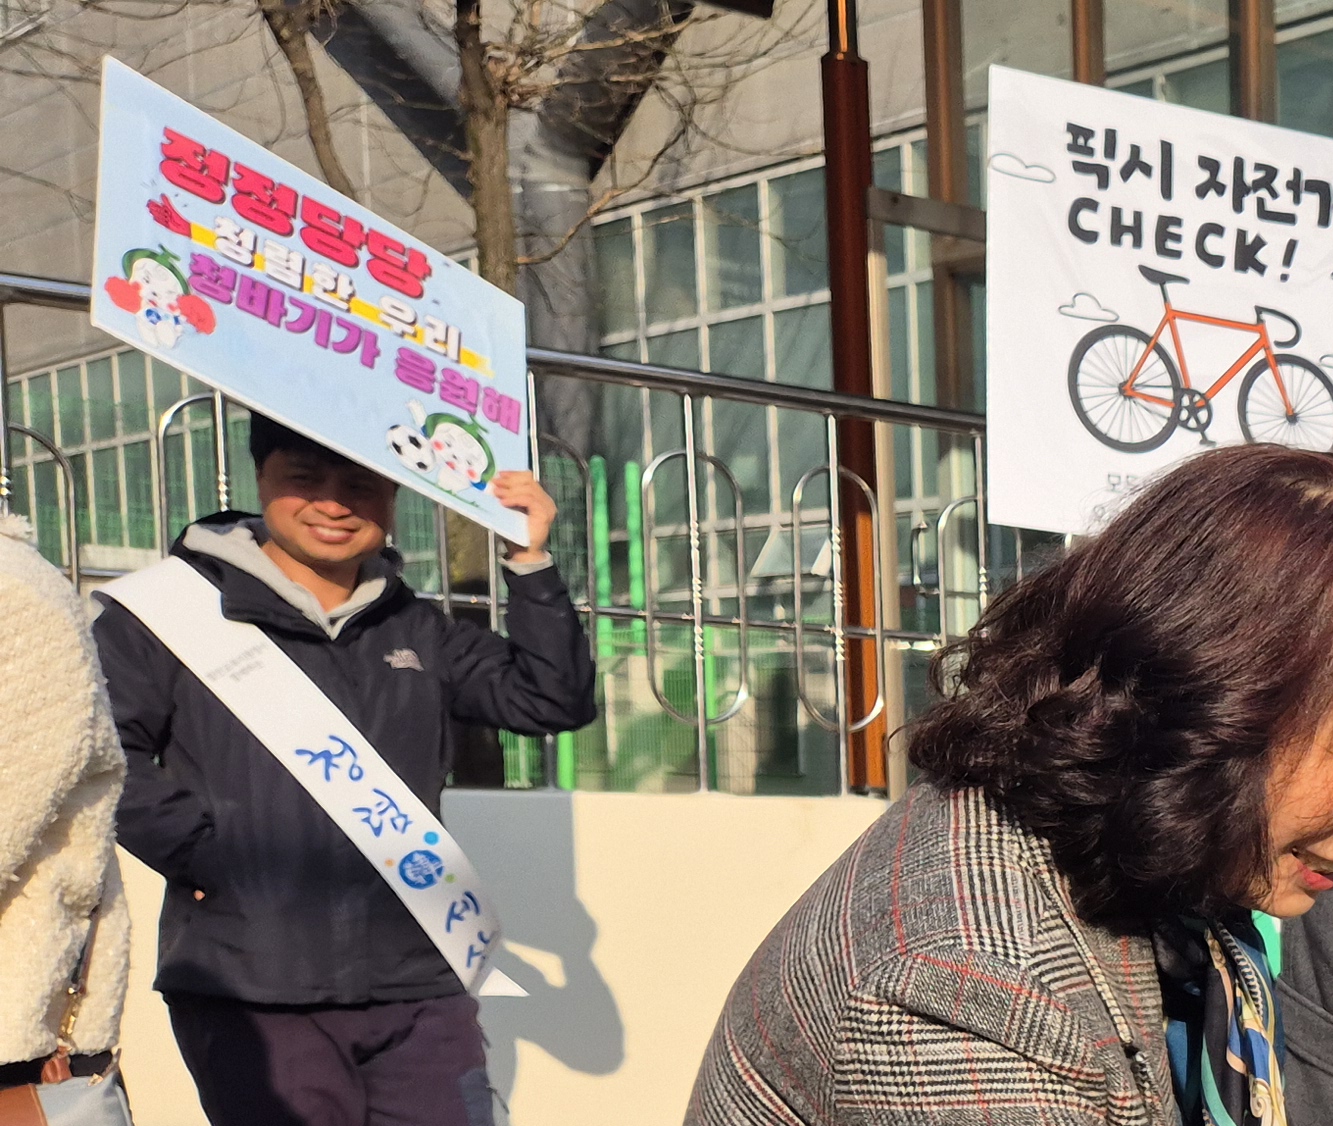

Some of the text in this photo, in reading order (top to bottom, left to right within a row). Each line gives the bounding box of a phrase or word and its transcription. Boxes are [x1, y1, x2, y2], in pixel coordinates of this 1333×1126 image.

[1066, 122, 1174, 201] 픽시
[159, 126, 432, 299] 정정당당
[1067, 197, 1299, 282] CHECK!
[214, 216, 463, 364] 청렴한 우리
[394, 346, 522, 435] 응원해
